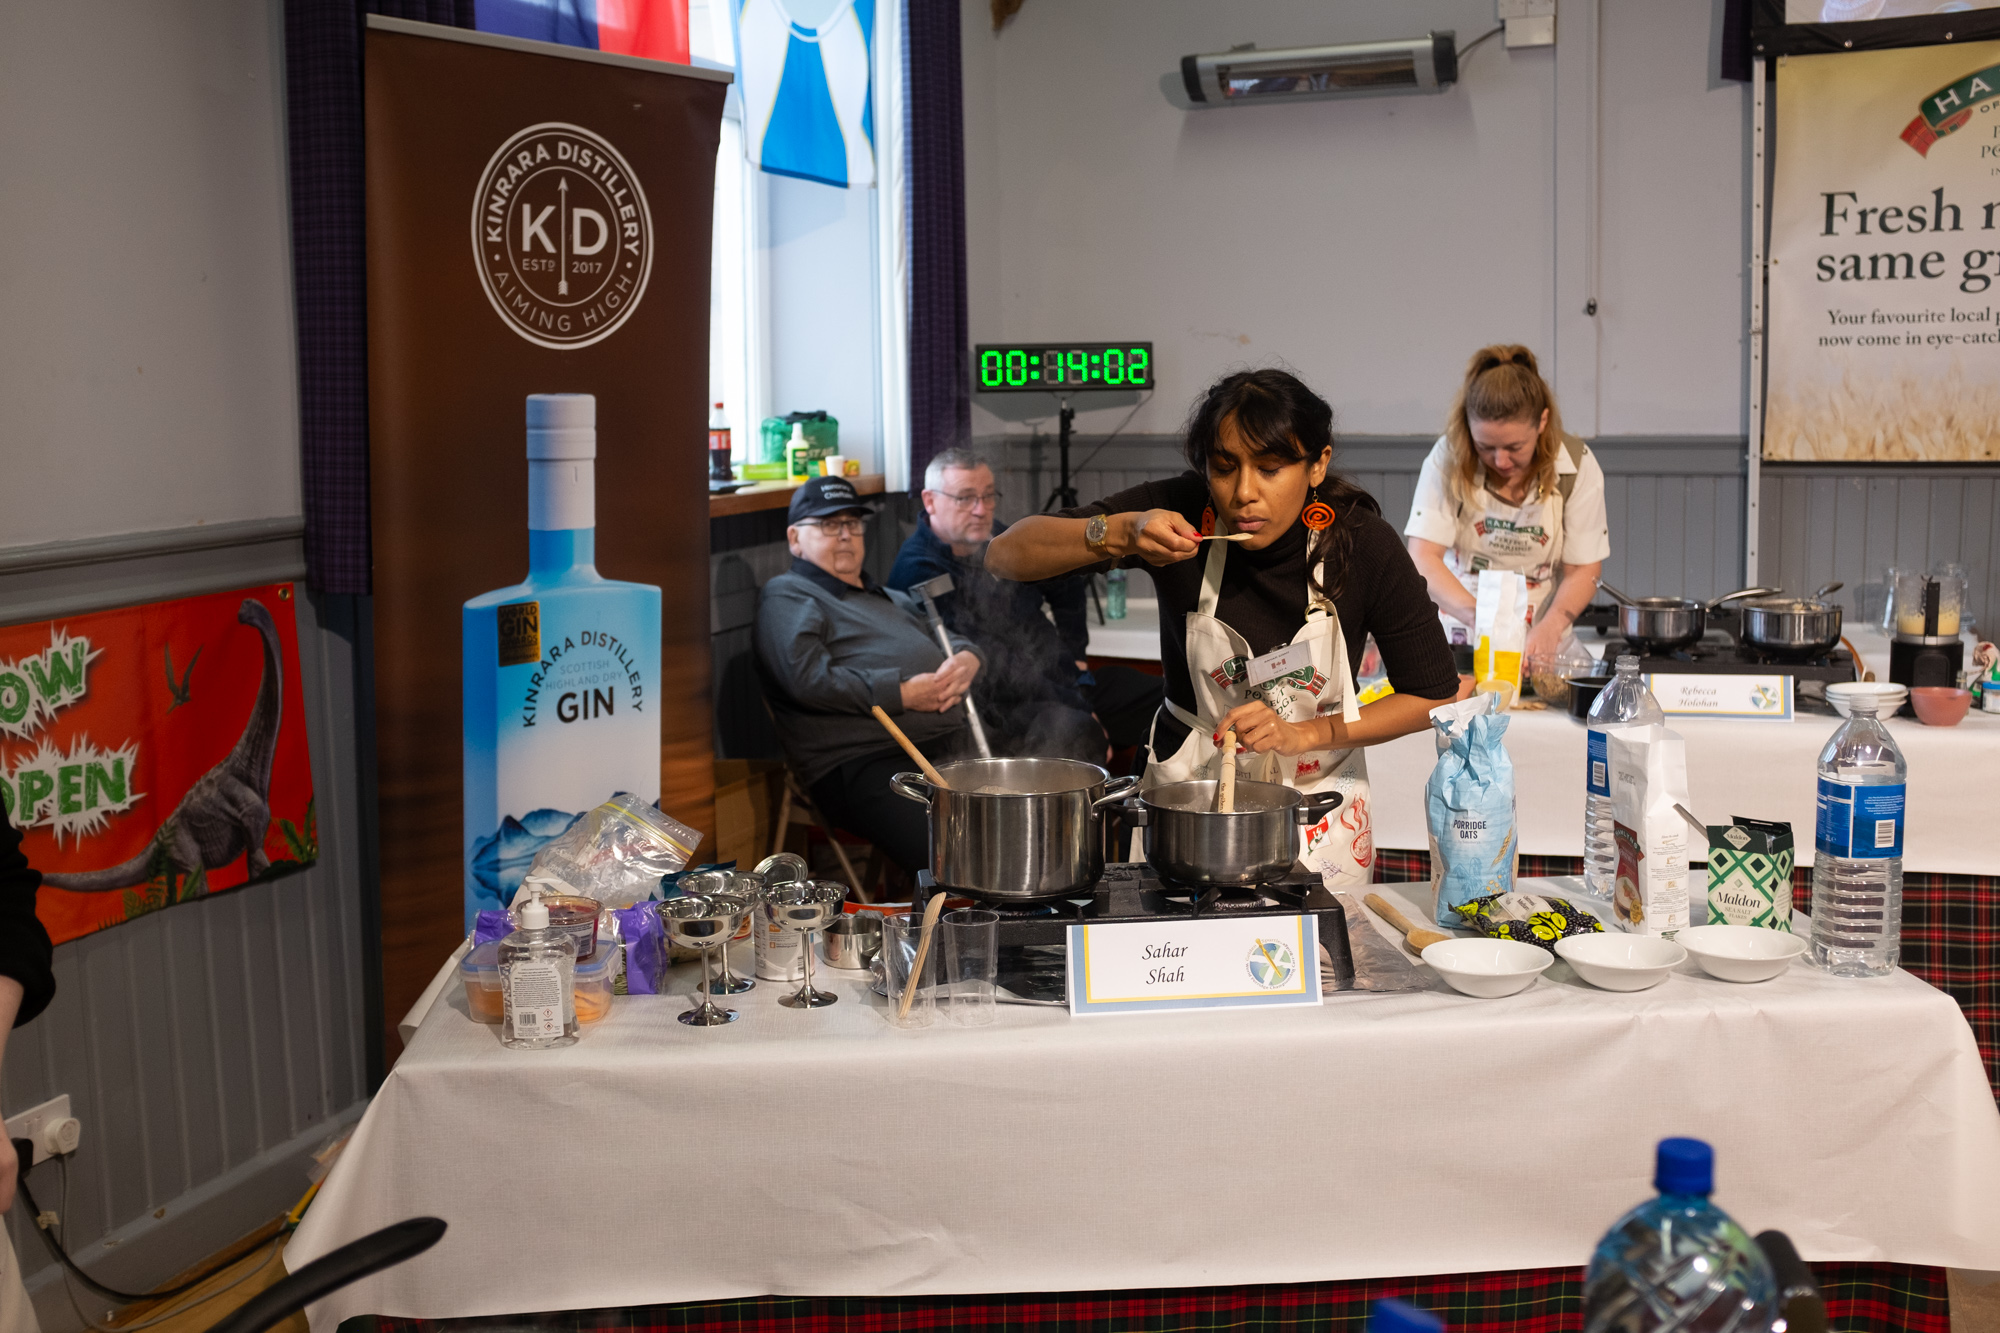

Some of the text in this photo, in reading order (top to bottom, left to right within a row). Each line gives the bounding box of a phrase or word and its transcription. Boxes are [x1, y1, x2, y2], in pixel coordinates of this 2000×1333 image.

[486, 141, 640, 256] KINRARA DISTILLERY
[1819, 186, 1964, 236] Fresh
[522, 203, 608, 256] K D
[572, 261, 602, 274] 2017
[1816, 251, 1946, 282] same
[494, 272, 632, 332] AIMING HIGH
[1828, 309, 1866, 326] Your
[1871, 308, 1946, 325] favourite
[1950, 306, 1990, 323] local
[1818, 335, 1852, 347] now
[1857, 334, 1901, 347] come
[1906, 331, 1922, 346] in
[981, 348, 1149, 387] 00:14:02
[500, 616, 538, 637] GIN
[559, 660, 610, 675] SCOTTISH
[523, 631, 643, 728] KINRARA DISTILLERY
[545, 671, 623, 691] HIGHLAND DRY
[1680, 686, 1717, 696] Rebecca
[556, 686, 614, 724] GIN
[1453, 819, 1487, 830] PORRIDGE
[1460, 830, 1478, 839] OATS
[1716, 891, 1762, 908] Maldon
[1725, 906, 1752, 915] SEA SALT
[1141, 941, 1189, 961] Sahar
[1145, 966, 1186, 985] Shah
